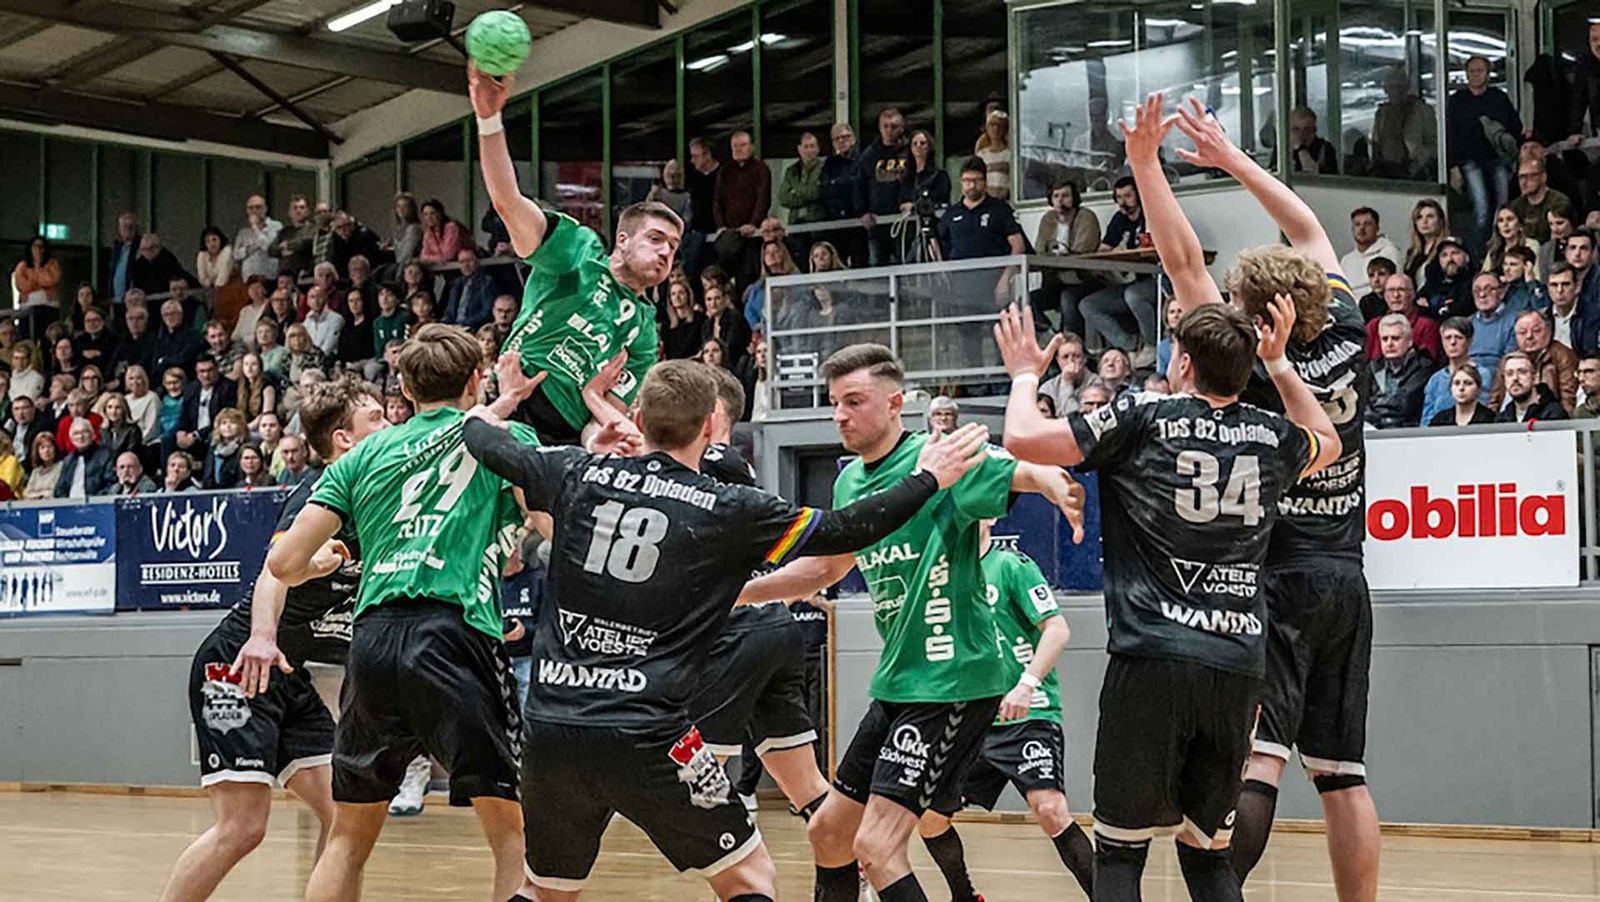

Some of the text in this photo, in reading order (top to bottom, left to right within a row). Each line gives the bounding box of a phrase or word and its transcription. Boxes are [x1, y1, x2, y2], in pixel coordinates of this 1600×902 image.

[1194, 417, 1217, 441] 82
[613, 469, 642, 492] 82
[641, 474, 717, 511] Opladen
[1174, 450, 1266, 527] 34
[151, 496, 228, 560] Victor's
[583, 499, 669, 583] 18
[142, 564, 240, 580] RESIDENZ-HOTELS
